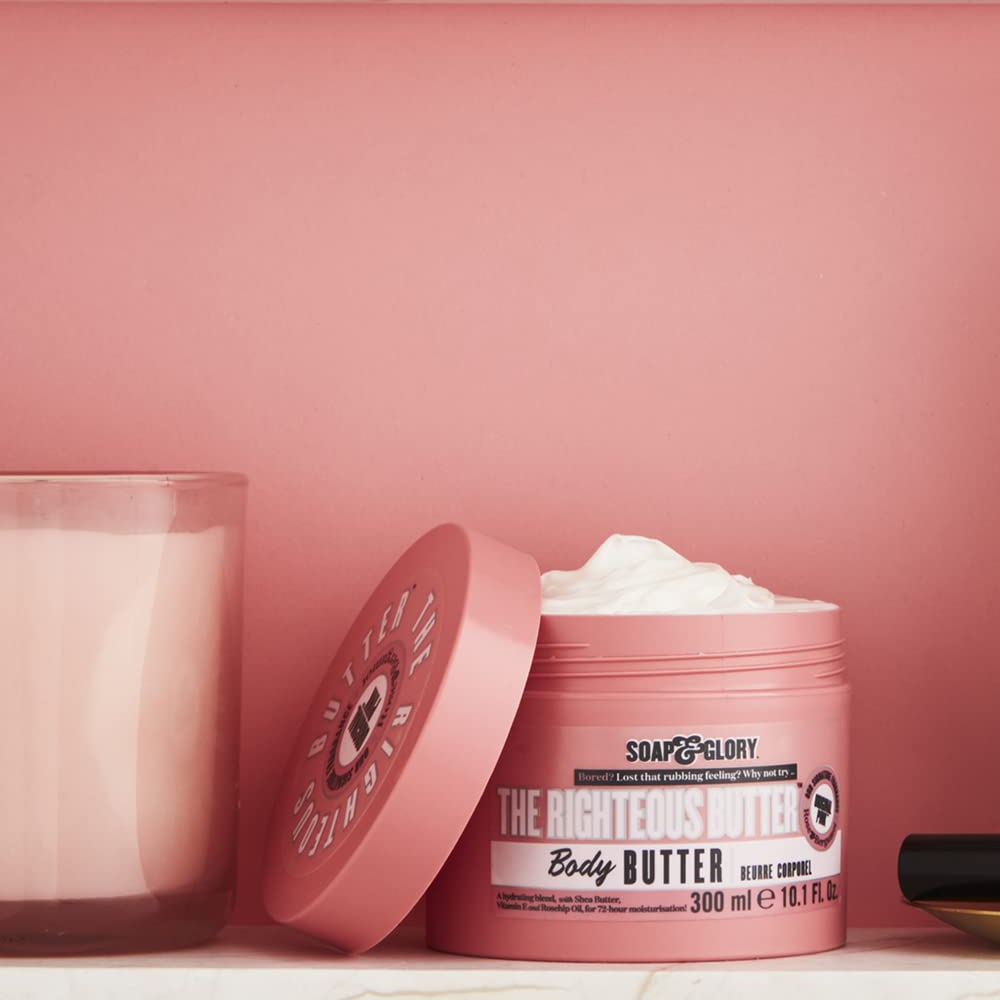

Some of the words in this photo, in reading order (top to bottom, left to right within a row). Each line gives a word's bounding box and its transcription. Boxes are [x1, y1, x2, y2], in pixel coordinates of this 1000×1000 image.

[626, 734, 758, 765] SOAP&GLORY
[578, 772, 614, 781] Bored?
[616, 772, 638, 781] Lost
[640, 772, 661, 781] that
[663, 771, 703, 783] rubbing
[705, 769, 742, 781] feeling?
[742, 769, 761, 780] Why
[763, 769, 776, 777] not
[497, 788, 543, 837] THE
[547, 785, 704, 840] RIGHTEOUS
[707, 784, 801, 837] BUTTER
[548, 848, 616, 887] Body
[623, 848, 723, 885] BUTTER
[740, 864, 773, 881] BEURRE
[777, 860, 812, 878] CORPOREL
[535, 893, 557, 903] blend,
[575, 895, 593, 903] Shea
[594, 895, 621, 904] Butter,
[541, 903, 570, 914] Rosehip
[585, 904, 596, 912] for
[597, 904, 627, 912] 72-hour
[628, 903, 687, 913] moisturisation!
[690, 891, 724, 913] 300
[731, 889, 752, 911] ml
[781, 884, 807, 908] 10.1
[812, 882, 824, 904] Fl.
